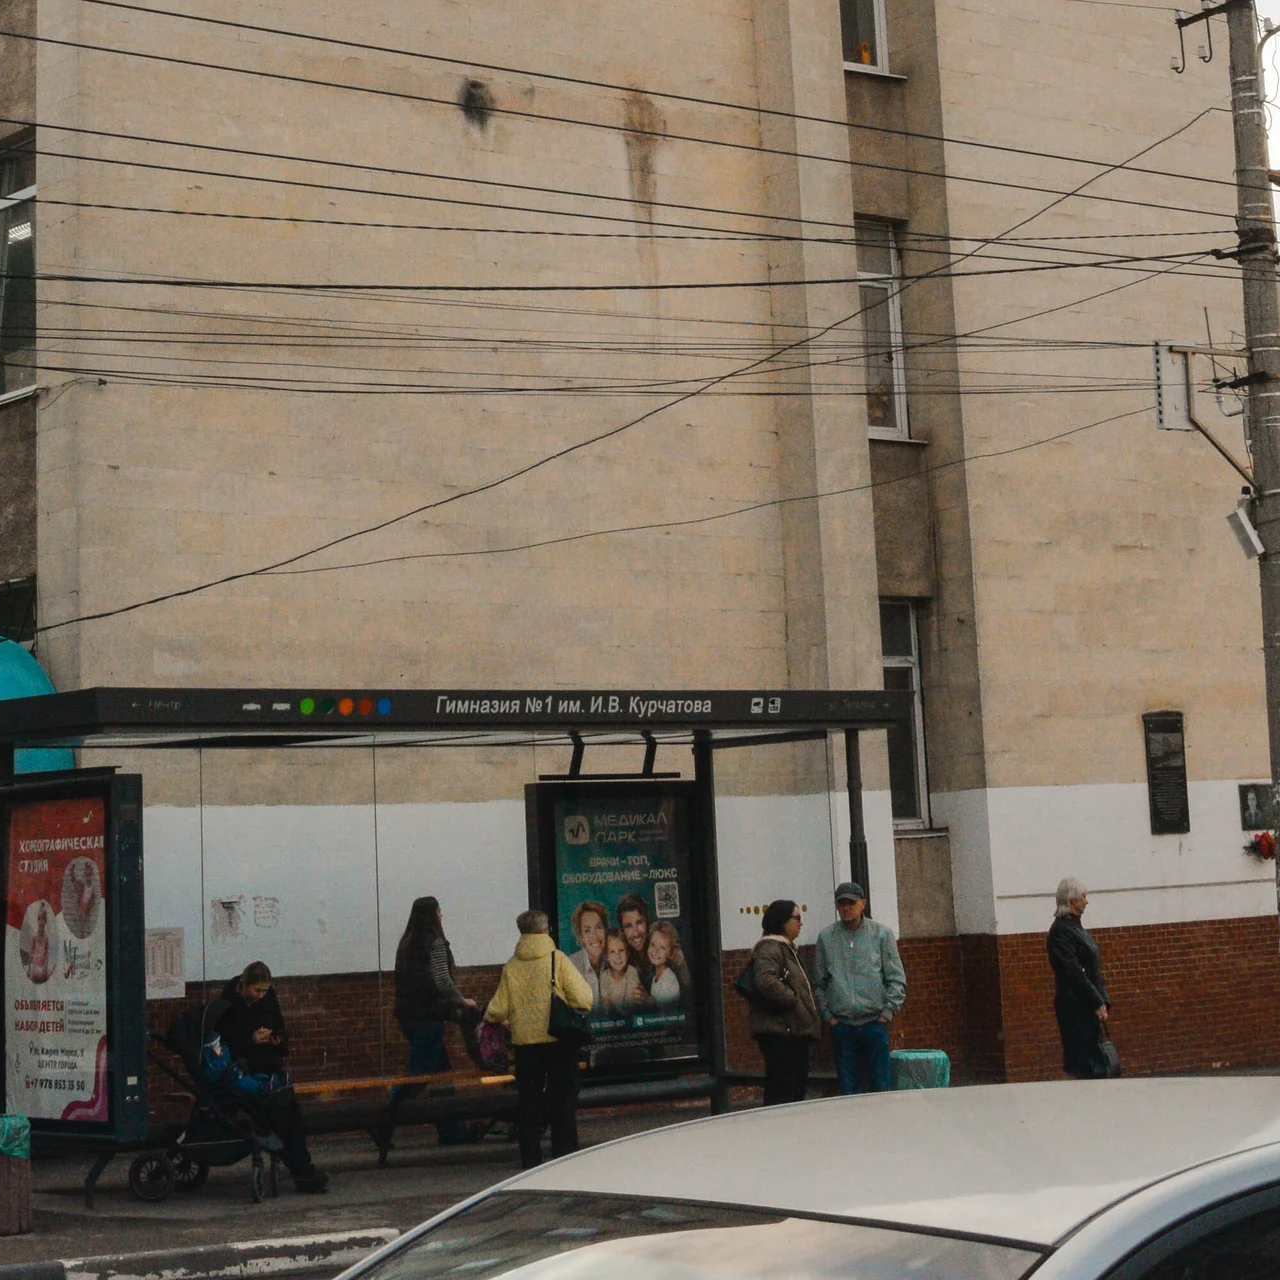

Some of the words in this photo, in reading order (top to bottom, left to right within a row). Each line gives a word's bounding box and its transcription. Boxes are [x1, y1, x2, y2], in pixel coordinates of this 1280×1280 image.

[436, 695, 520, 714] Гимназия
[526, 696, 552, 714] №1
[558, 700, 585, 714] им.
[590, 696, 623, 714] И.В.
[628, 696, 712, 718] Курчатова
[594, 812, 668, 827] МЕДИКАЛ
[594, 831, 636, 844] ПАРК
[19, 859, 49, 874] СТУДИЯ
[589, 857, 620, 868] ВРАЧИ
[562, 871, 642, 885] ОБОРУДОВАНИЕ
[649, 868, 678, 880] ЛЮКС
[39, 1018, 64, 1034] ДЕТЕЙ
